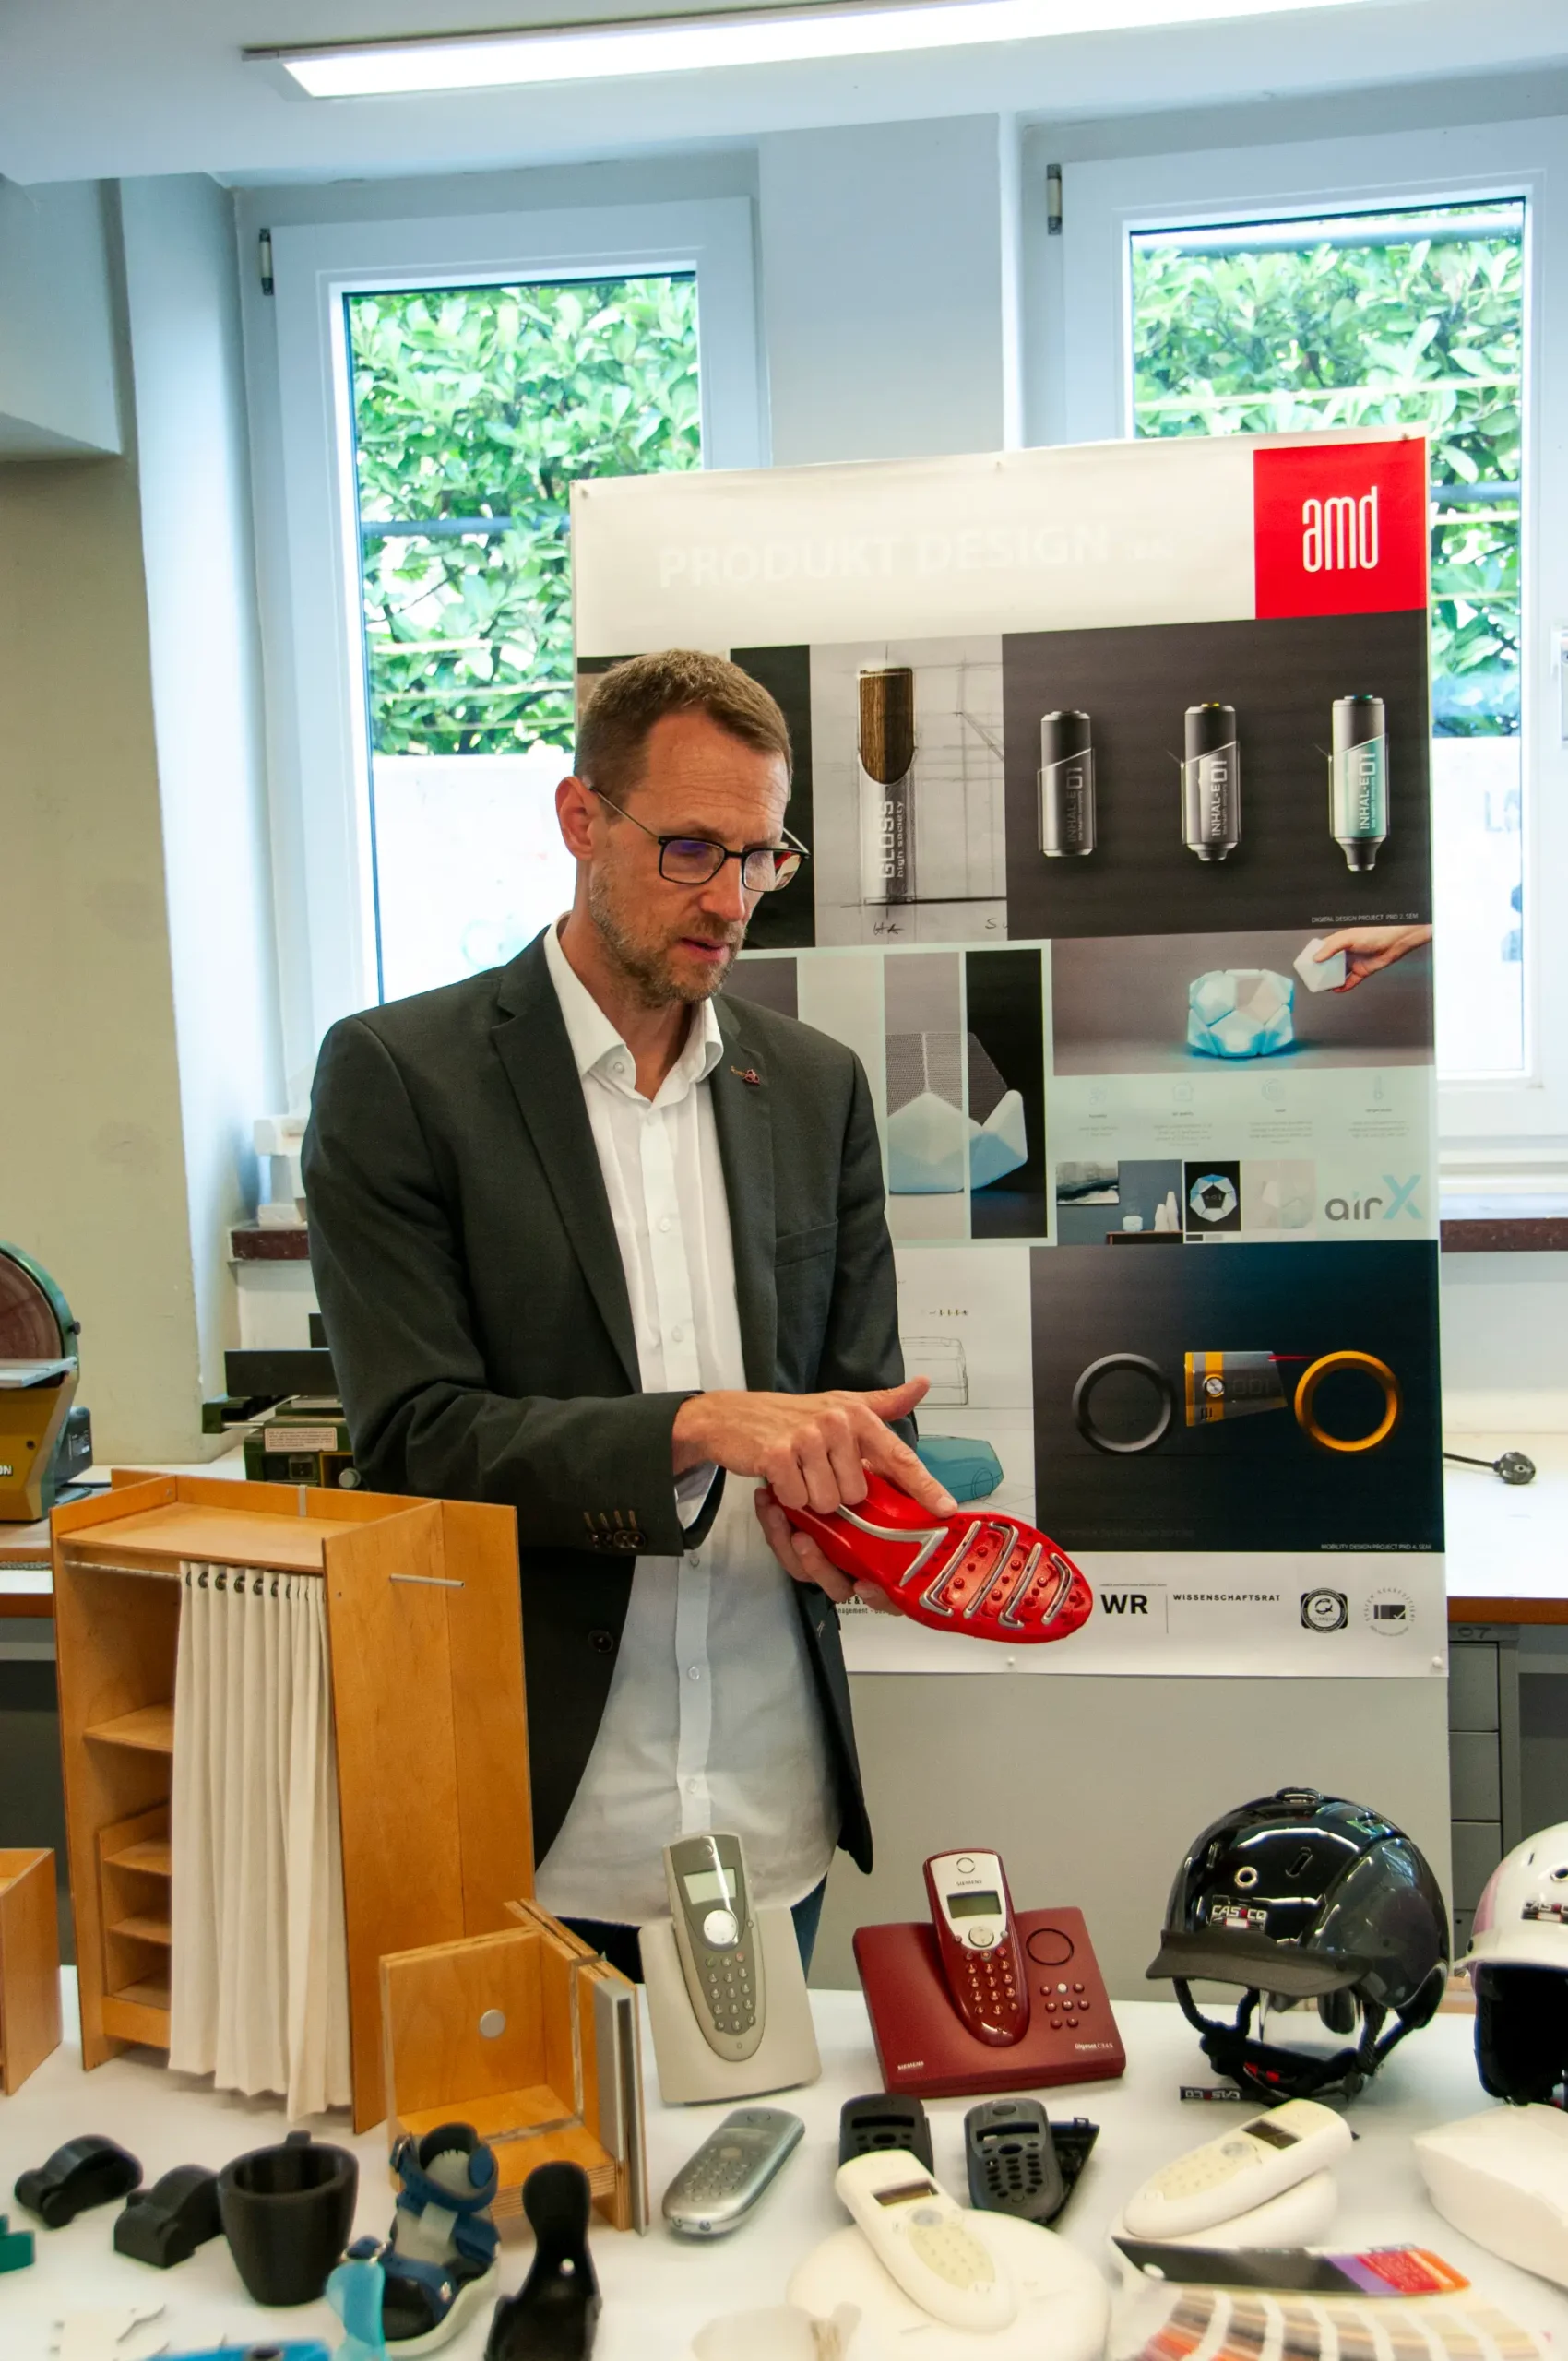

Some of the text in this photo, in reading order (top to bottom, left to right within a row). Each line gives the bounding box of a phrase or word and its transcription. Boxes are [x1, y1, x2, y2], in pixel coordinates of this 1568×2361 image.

[1302, 485, 1379, 573] amd
[659, 534, 901, 587] PRODUKT
[916, 523, 1109, 577] DESIGN
[879, 801, 895, 878] GLOSS
[897, 850, 905, 878] high
[1358, 913, 1384, 921] PROJECT
[1324, 1173, 1424, 1221] airX
[1100, 1594, 1148, 1614] WR
[1172, 1594, 1281, 1602] WISSENSCHAFTSRAT
[897, 2060, 924, 2070] SIEMENS
